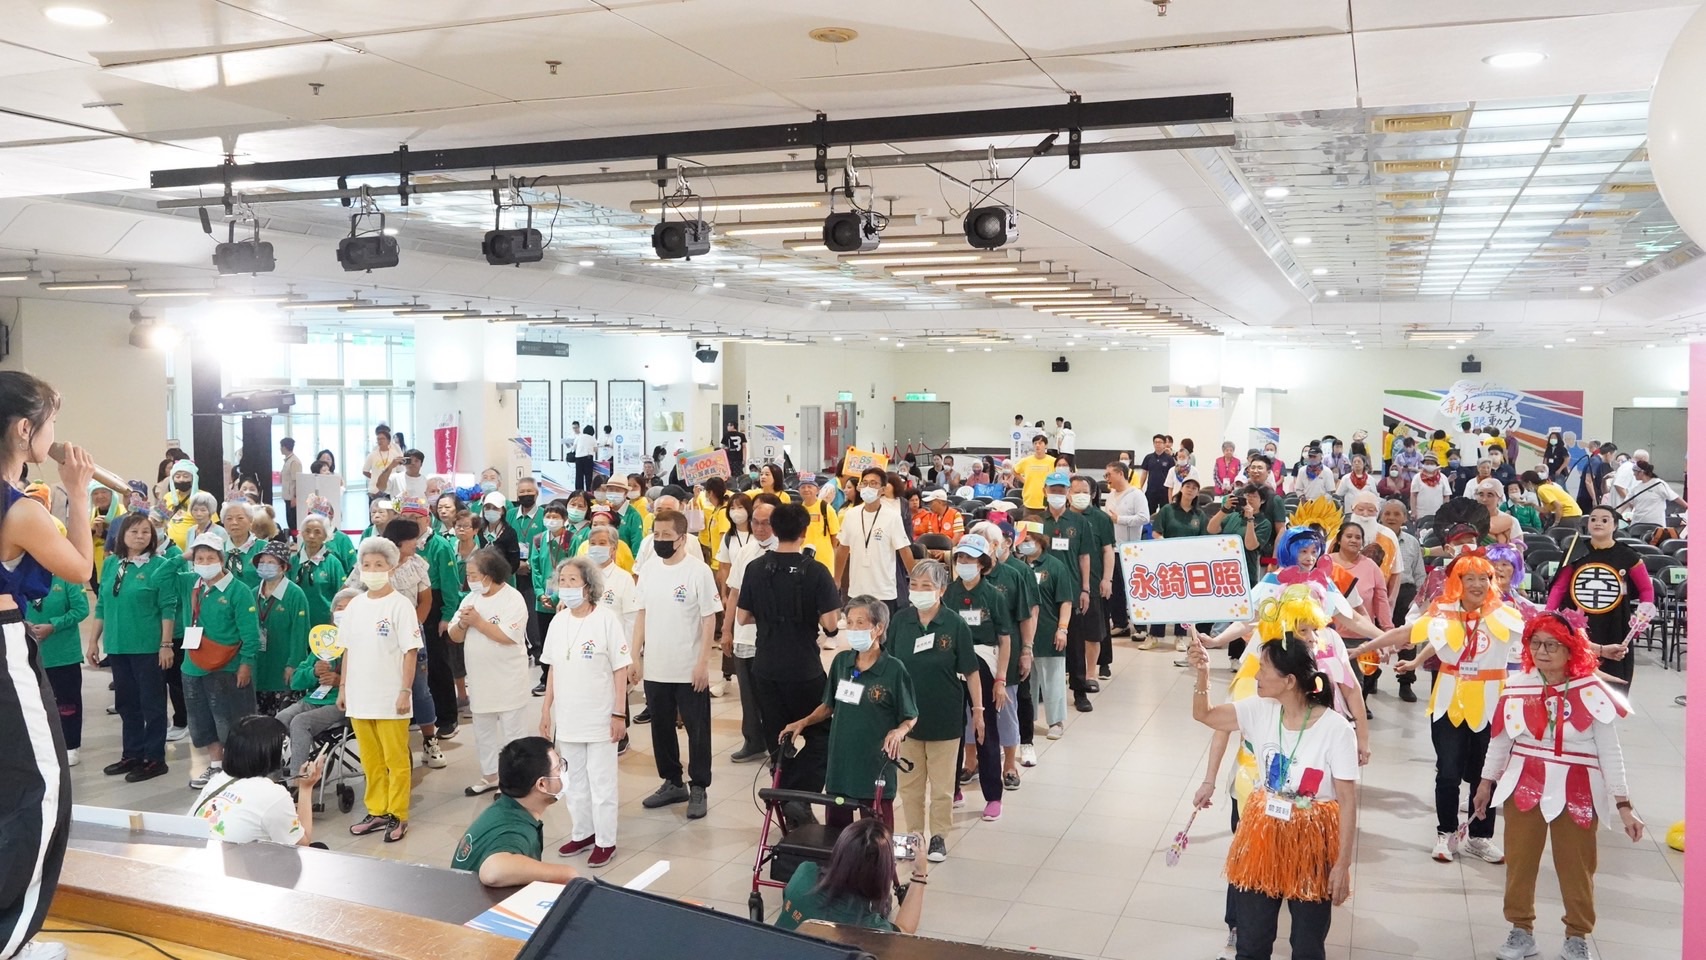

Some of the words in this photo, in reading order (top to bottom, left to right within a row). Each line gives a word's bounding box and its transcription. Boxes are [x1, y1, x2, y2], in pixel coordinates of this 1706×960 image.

[1445, 396, 1515, 415] 新北好樣
[1130, 560, 1245, 600] 永錡日照
